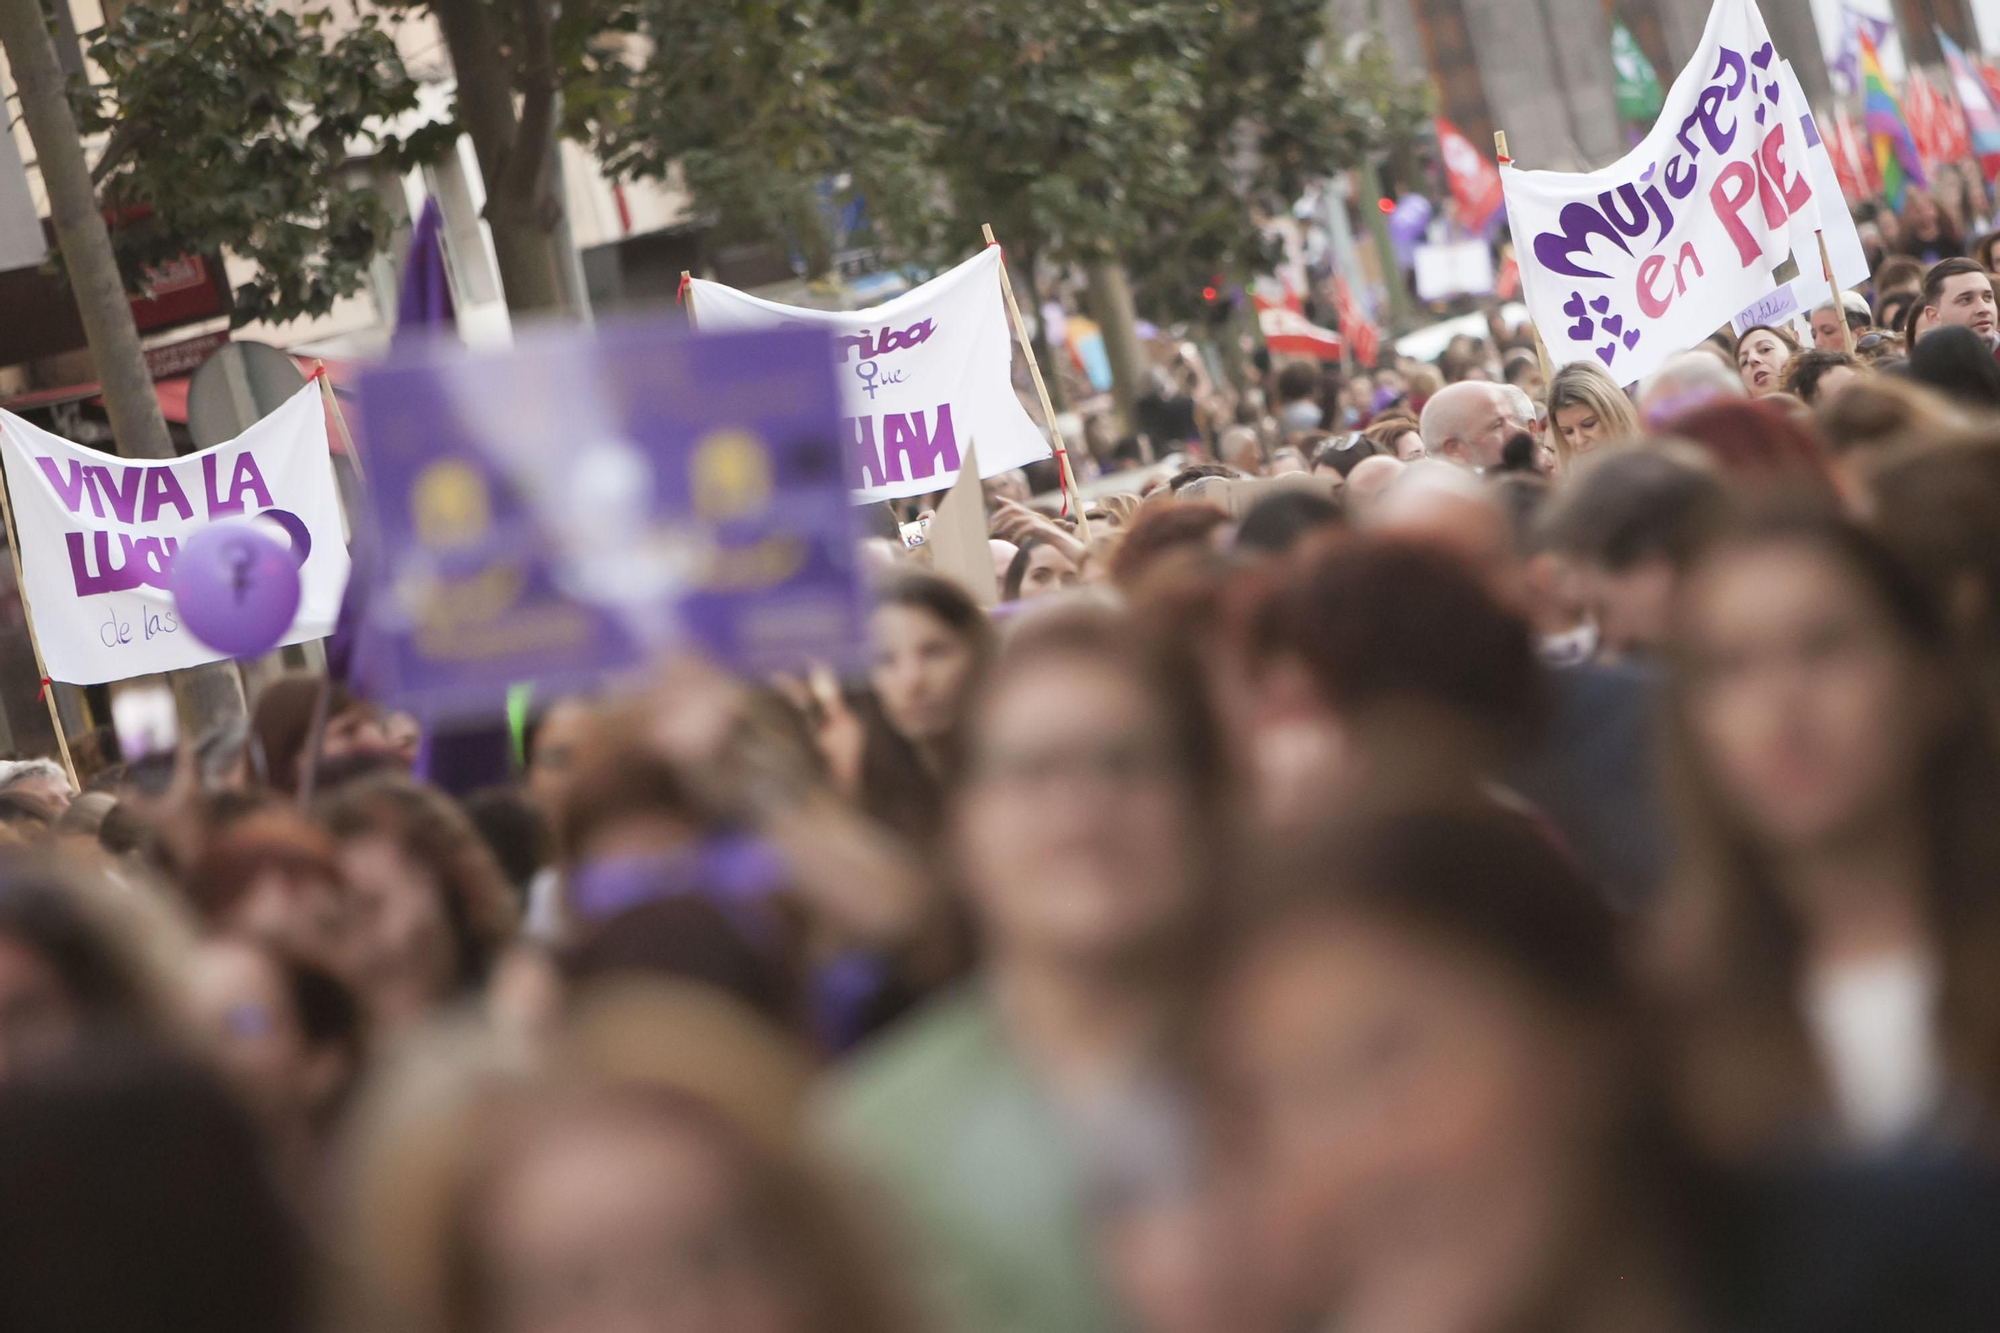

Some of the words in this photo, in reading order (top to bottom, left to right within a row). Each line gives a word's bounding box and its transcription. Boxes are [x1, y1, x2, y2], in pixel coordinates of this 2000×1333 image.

[1635, 241, 1704, 319] en
[1709, 122, 1812, 268] PIE
[202, 451, 274, 522] LA
[100, 608, 133, 648] de
[143, 605, 178, 640] las
